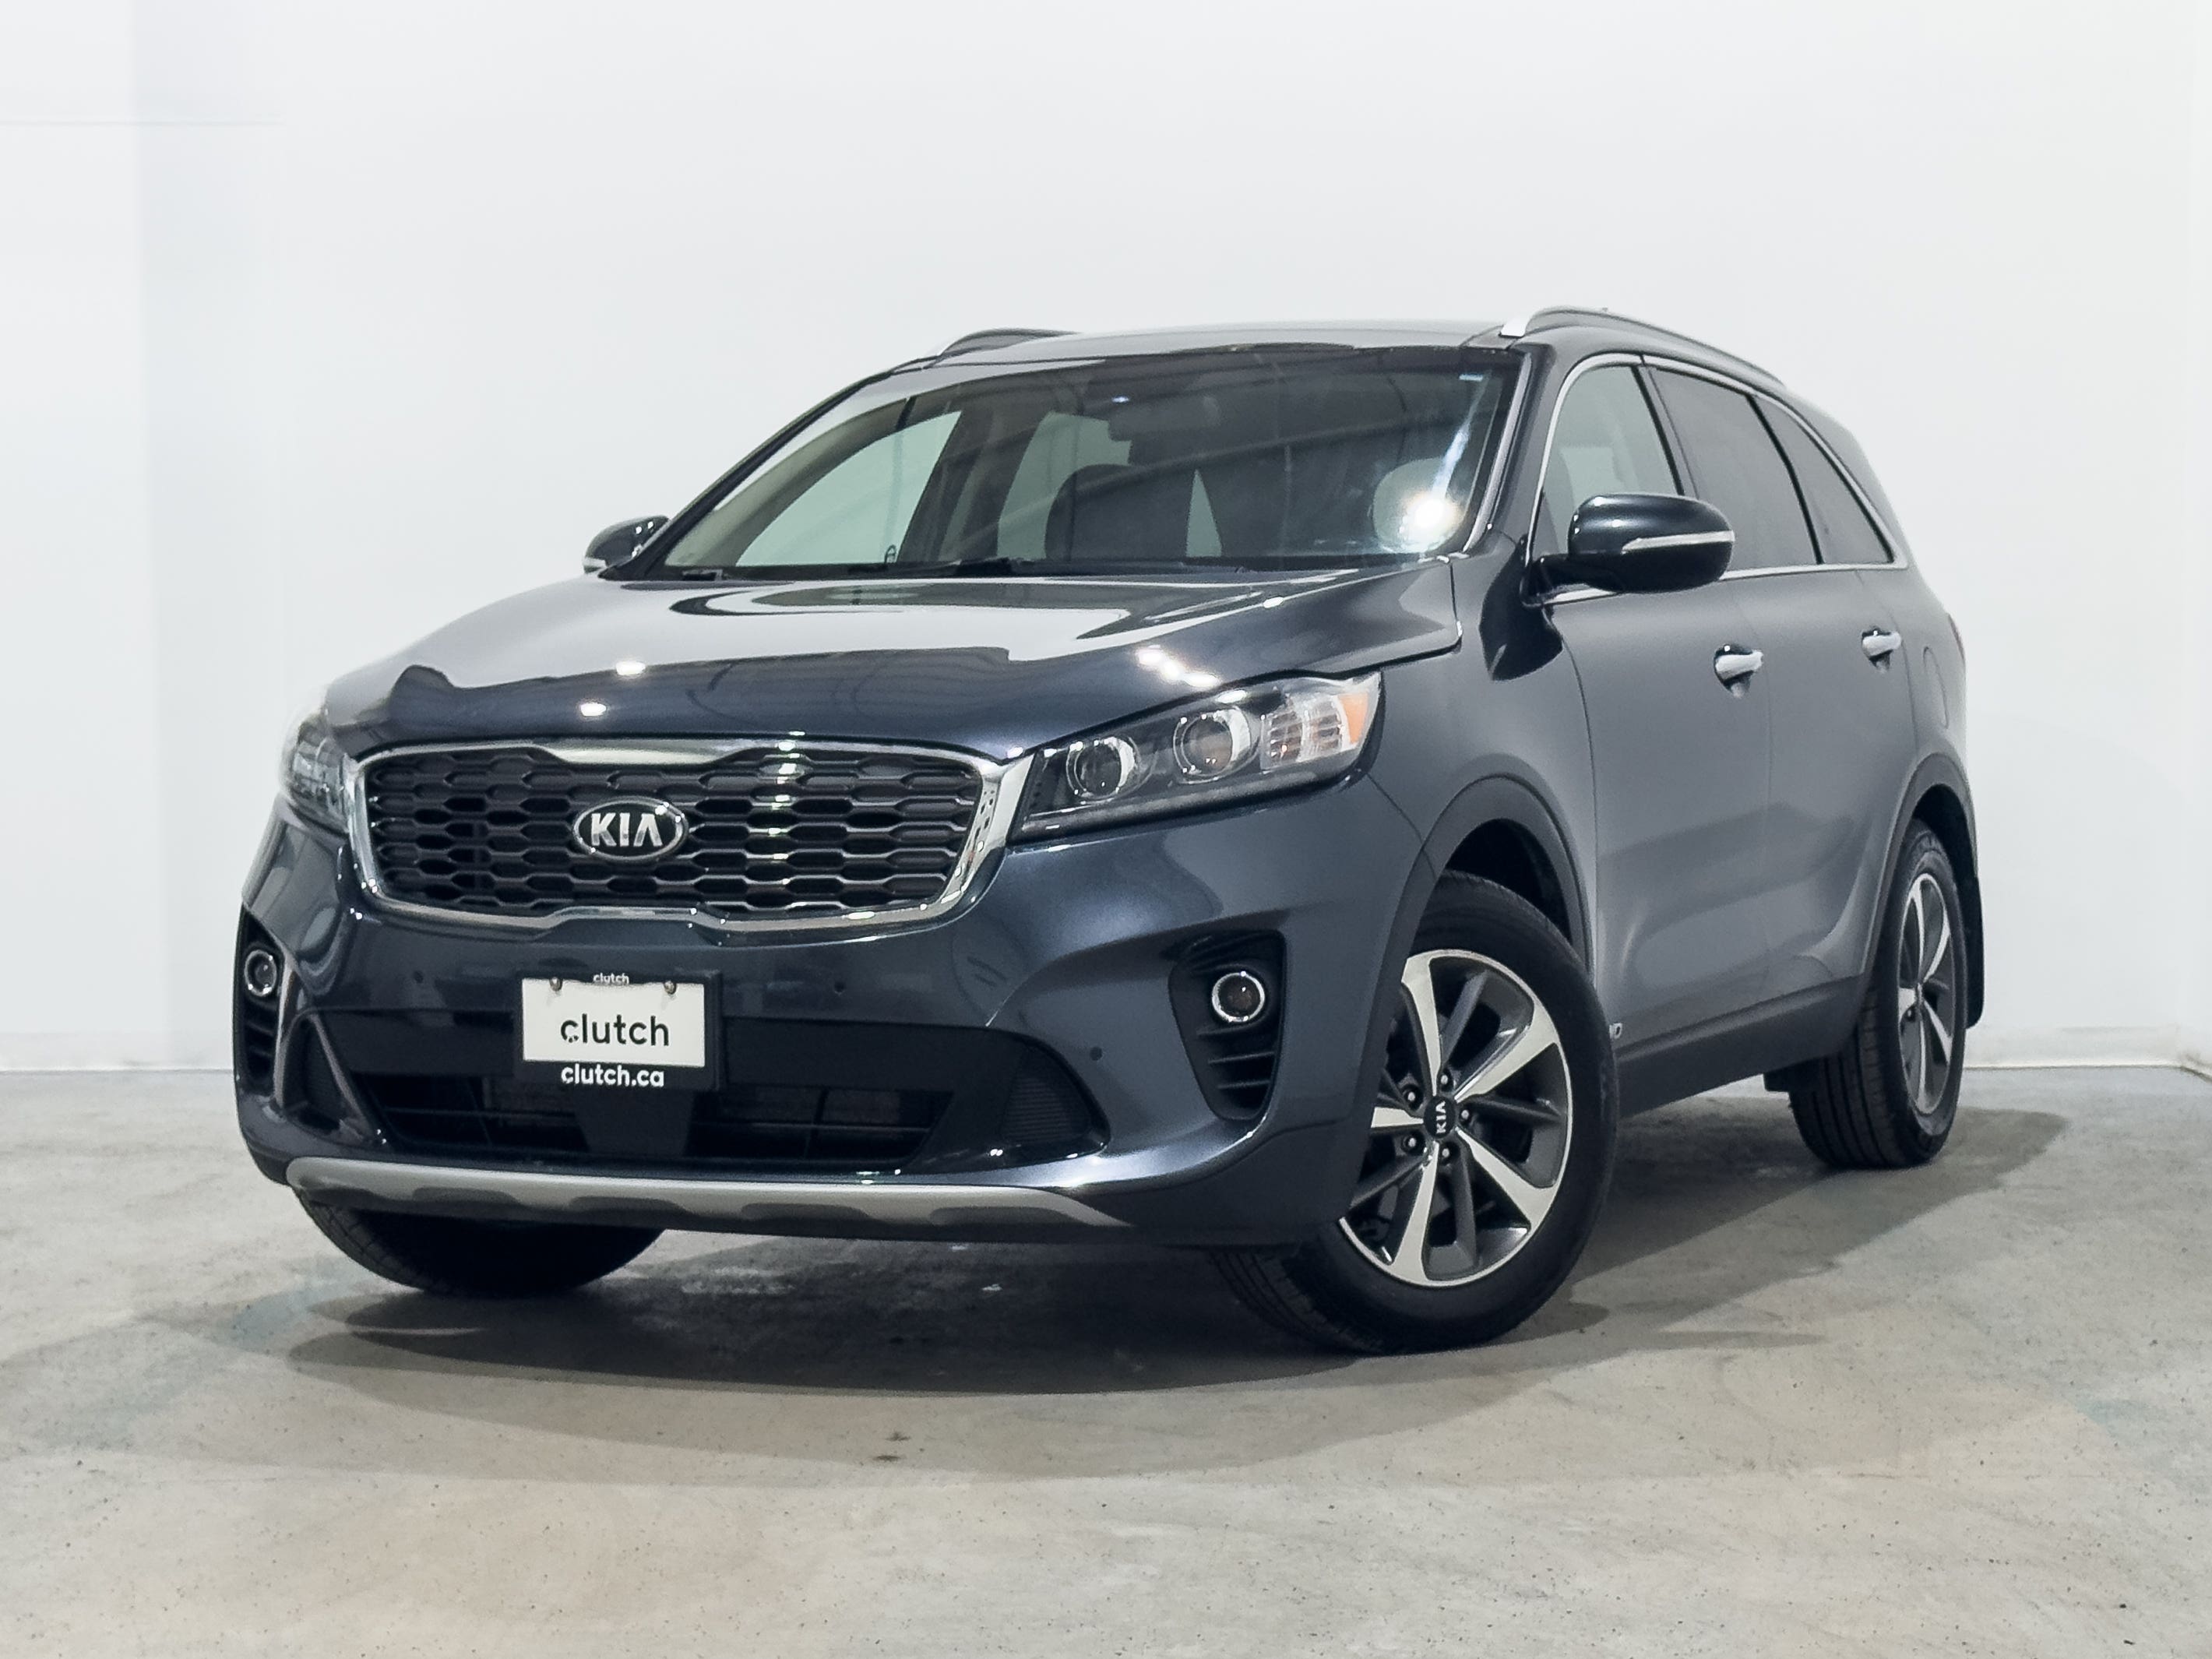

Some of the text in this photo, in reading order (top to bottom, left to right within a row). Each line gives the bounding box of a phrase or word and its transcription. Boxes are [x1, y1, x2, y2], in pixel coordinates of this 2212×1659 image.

[590, 812, 663, 847] KIA
[593, 972, 629, 984] clutch
[561, 1013, 669, 1046] clutch
[561, 1063, 664, 1087] clutch.ca
[1435, 1101, 1447, 1134] KIA
